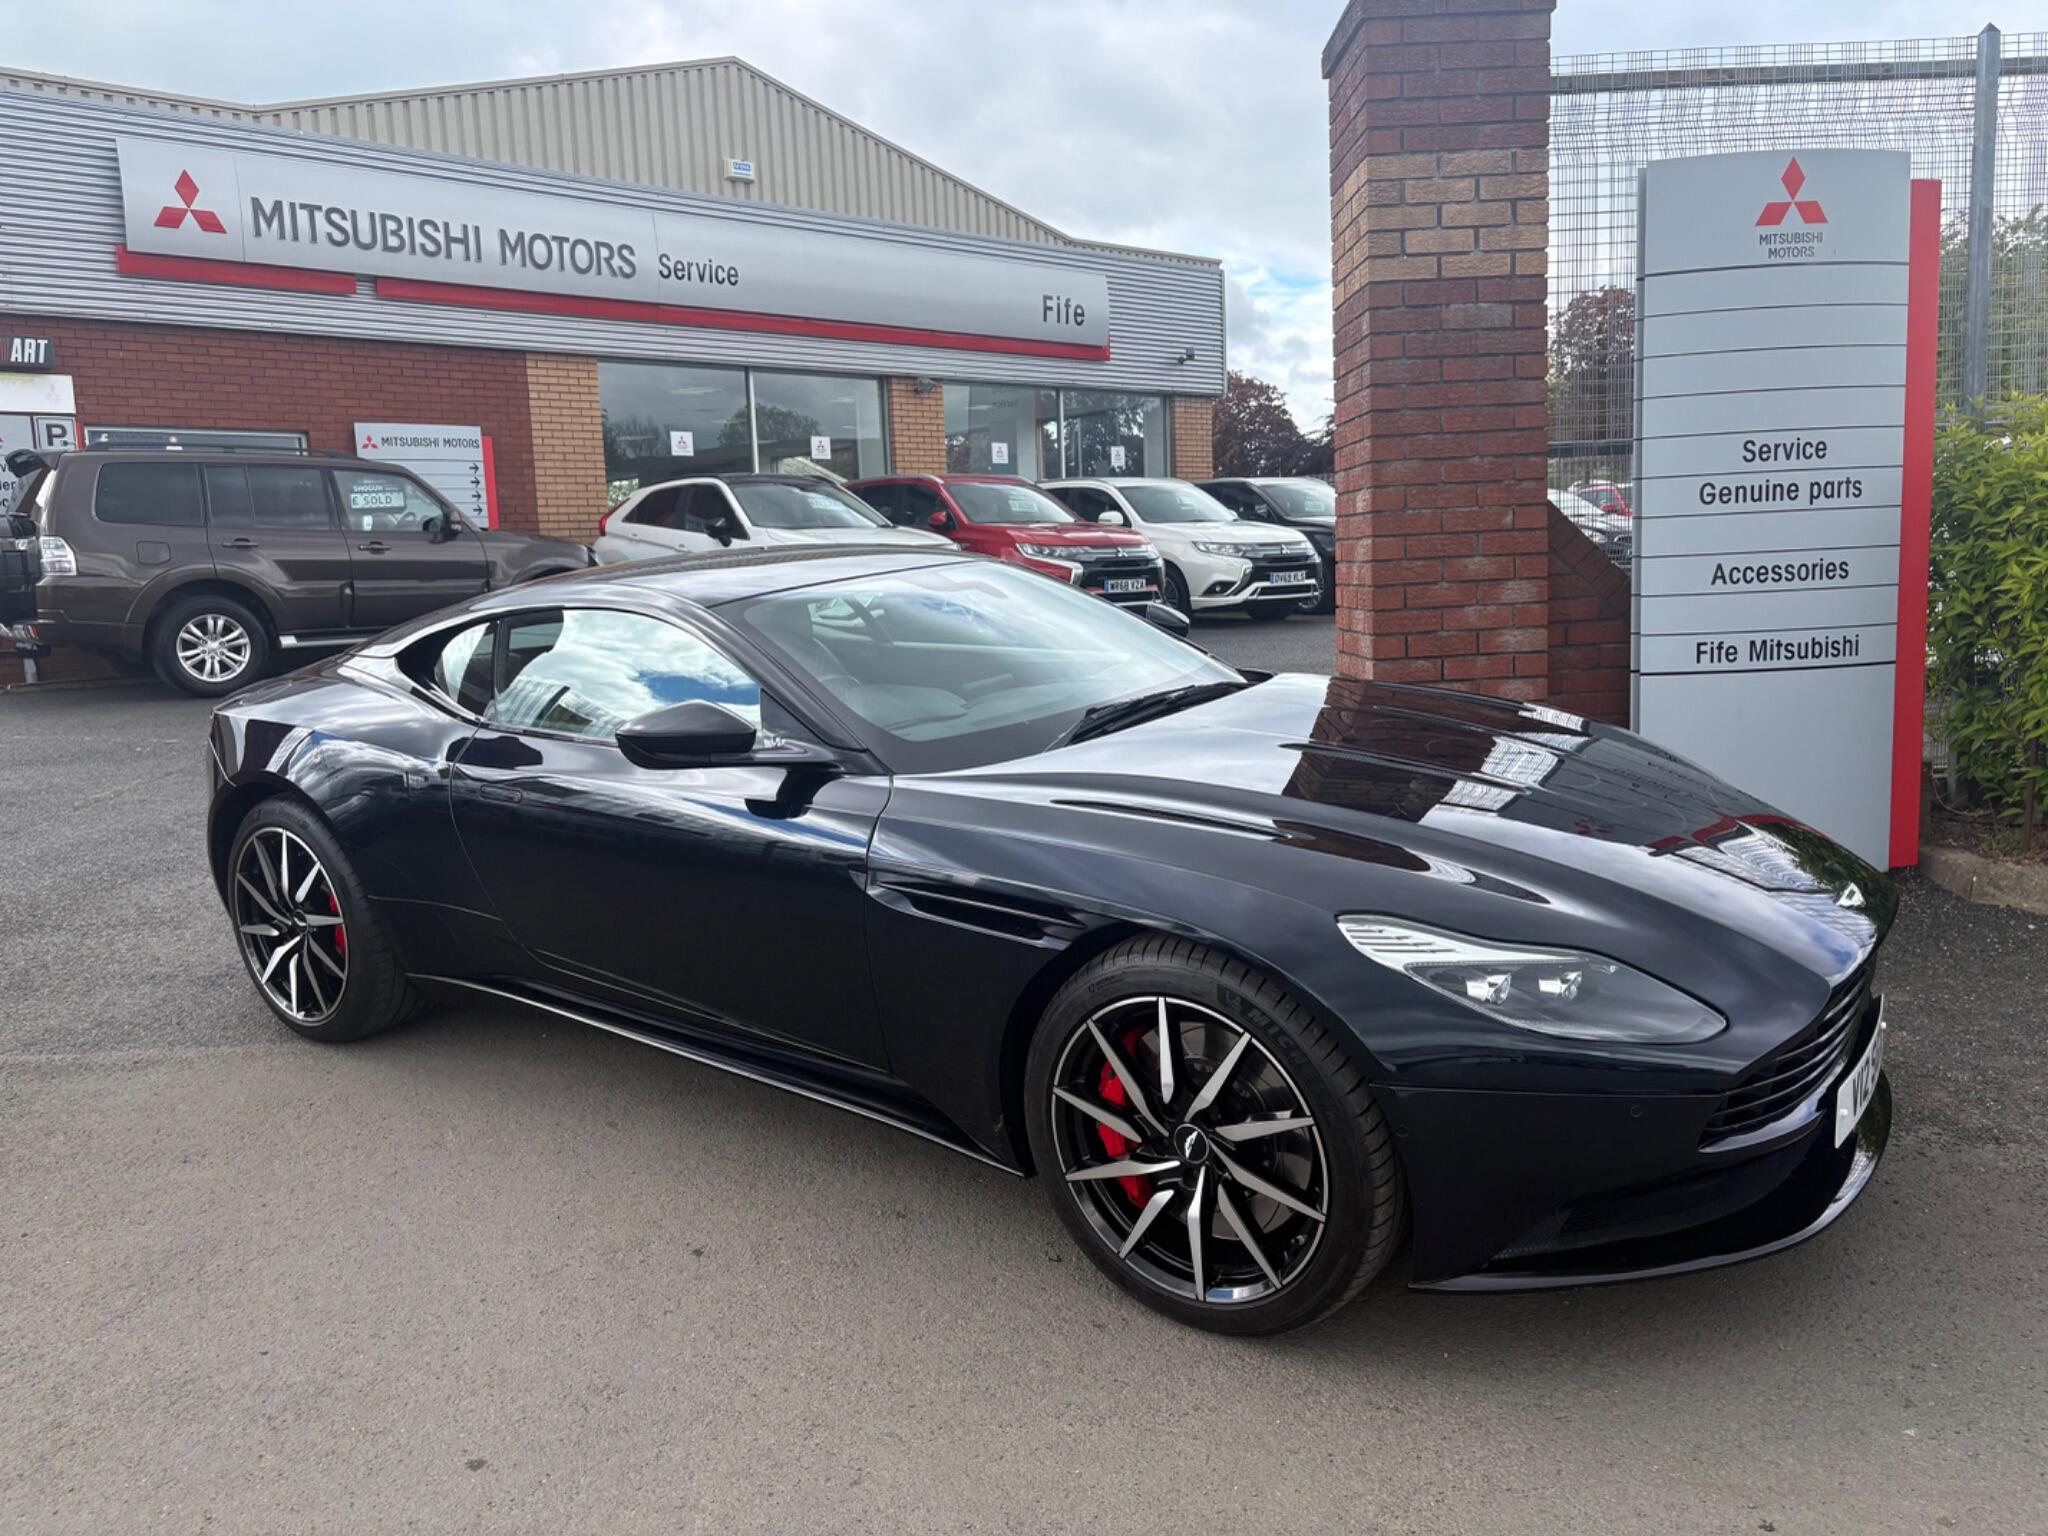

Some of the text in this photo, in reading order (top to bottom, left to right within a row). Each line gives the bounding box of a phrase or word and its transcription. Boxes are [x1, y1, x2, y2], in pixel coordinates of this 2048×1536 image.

[250, 196, 740, 286] MITSUBISHI MOTORS Service
[1759, 231, 1824, 246] MITSUBISHI
[1768, 246, 1815, 259] MOTORS
[1042, 294, 1085, 327] Fife
[381, 436, 480, 449] MITSUBISHI MOTORS
[1742, 436, 1828, 464] Service
[363, 495, 393, 506] SOLD
[1699, 476, 1863, 506] Genuine parts
[1710, 557, 1850, 586] Accessories
[1696, 634, 1860, 665] Fife Mitsubishi
